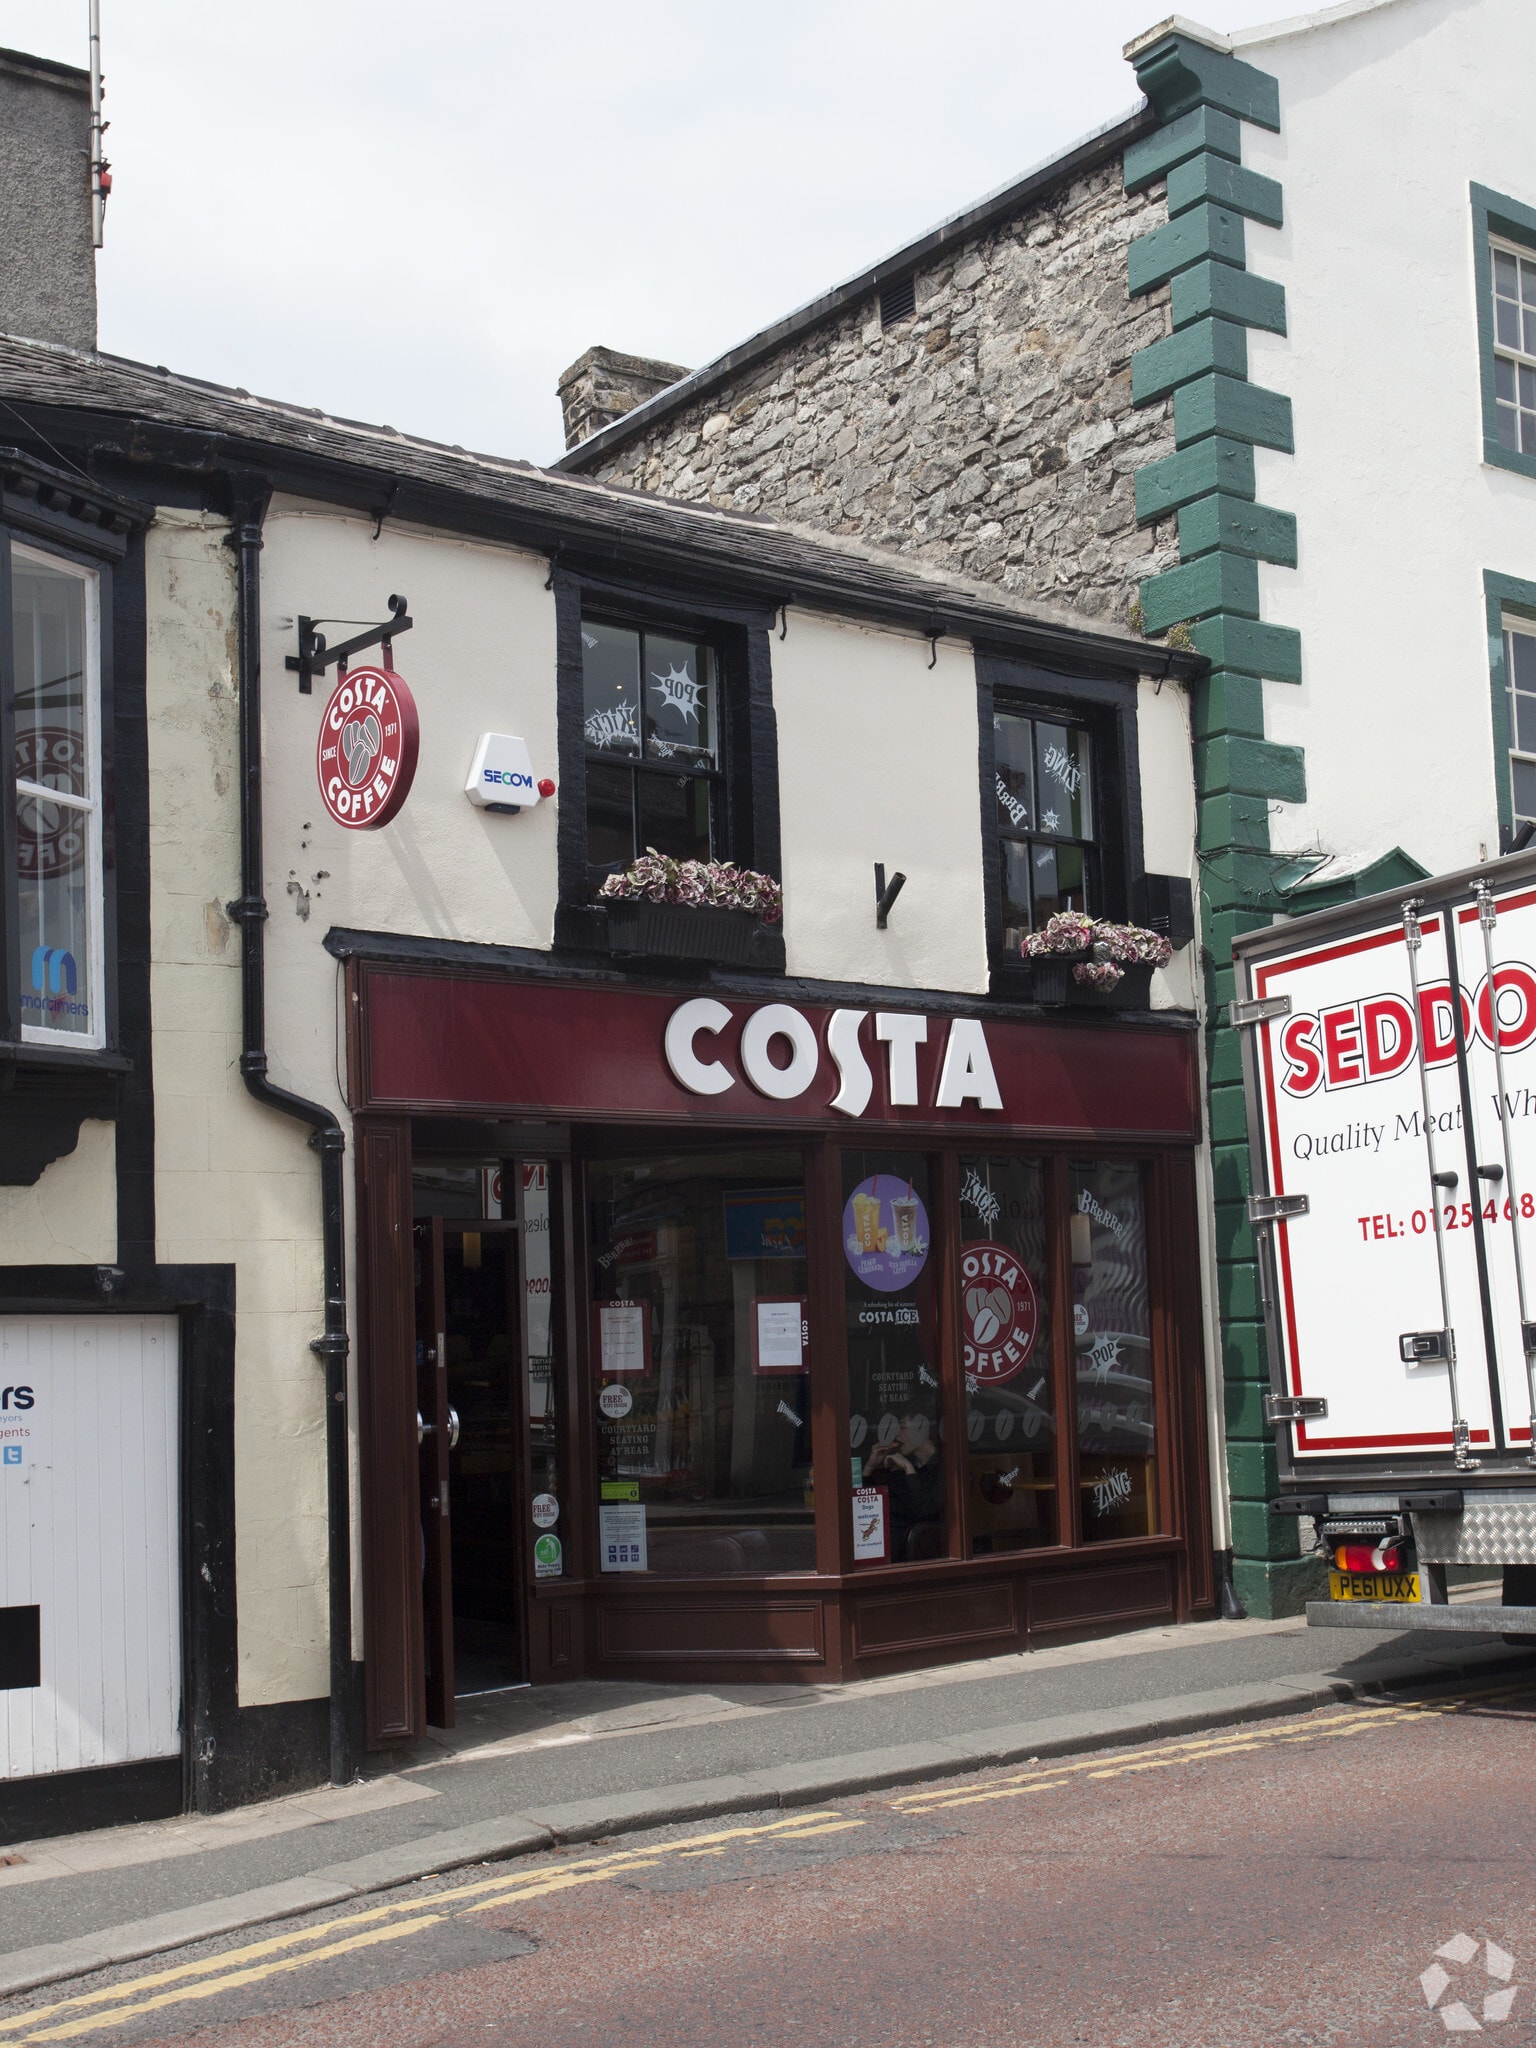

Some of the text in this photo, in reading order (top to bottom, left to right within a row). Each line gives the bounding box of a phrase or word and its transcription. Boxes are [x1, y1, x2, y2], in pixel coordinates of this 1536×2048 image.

[330, 677, 387, 731] COSTA
[385, 722, 397, 737] 1971
[322, 745, 337, 761] SINCE
[328, 755, 396, 818] COFFEE
[484, 769, 533, 788] SECOM
[20, 994, 89, 1016] mortimers
[1281, 962, 1536, 1098] SEDDO
[665, 998, 1003, 1118] COSTA
[1293, 1122, 1385, 1160] Quality
[1393, 1104, 1463, 1141] Meat
[963, 1173, 999, 1222] KICK
[863, 1213, 871, 1247] COSTA
[901, 1213, 910, 1246] COSTA
[1357, 1213, 1405, 1241] TEL:
[961, 1252, 1019, 1291] OSTA
[609, 1300, 635, 1308] COSTA
[1017, 1301, 1031, 1312] 1971
[858, 1310, 918, 1324] COSTA ICE
[801, 1320, 809, 1347] COSTA
[964, 1327, 1029, 1373] OFFEE
[1092, 1342, 1115, 1368] POP
[872, 1372, 914, 1382] COURTYARD
[878, 1382, 908, 1392] SEATING
[602, 1394, 623, 1404] FREE
[879, 1394, 888, 1403] AT
[601, 1423, 657, 1434] COURTYARD
[609, 1434, 649, 1445] SEATING
[610, 1445, 650, 1456] AT REAR
[856, 1487, 877, 1496] COSTA
[857, 1496, 879, 1504] COSTA
[1093, 1471, 1132, 1511] ZING
[533, 1504, 551, 1513] FREE
[1340, 1575, 1417, 1598] PE61 UXX
